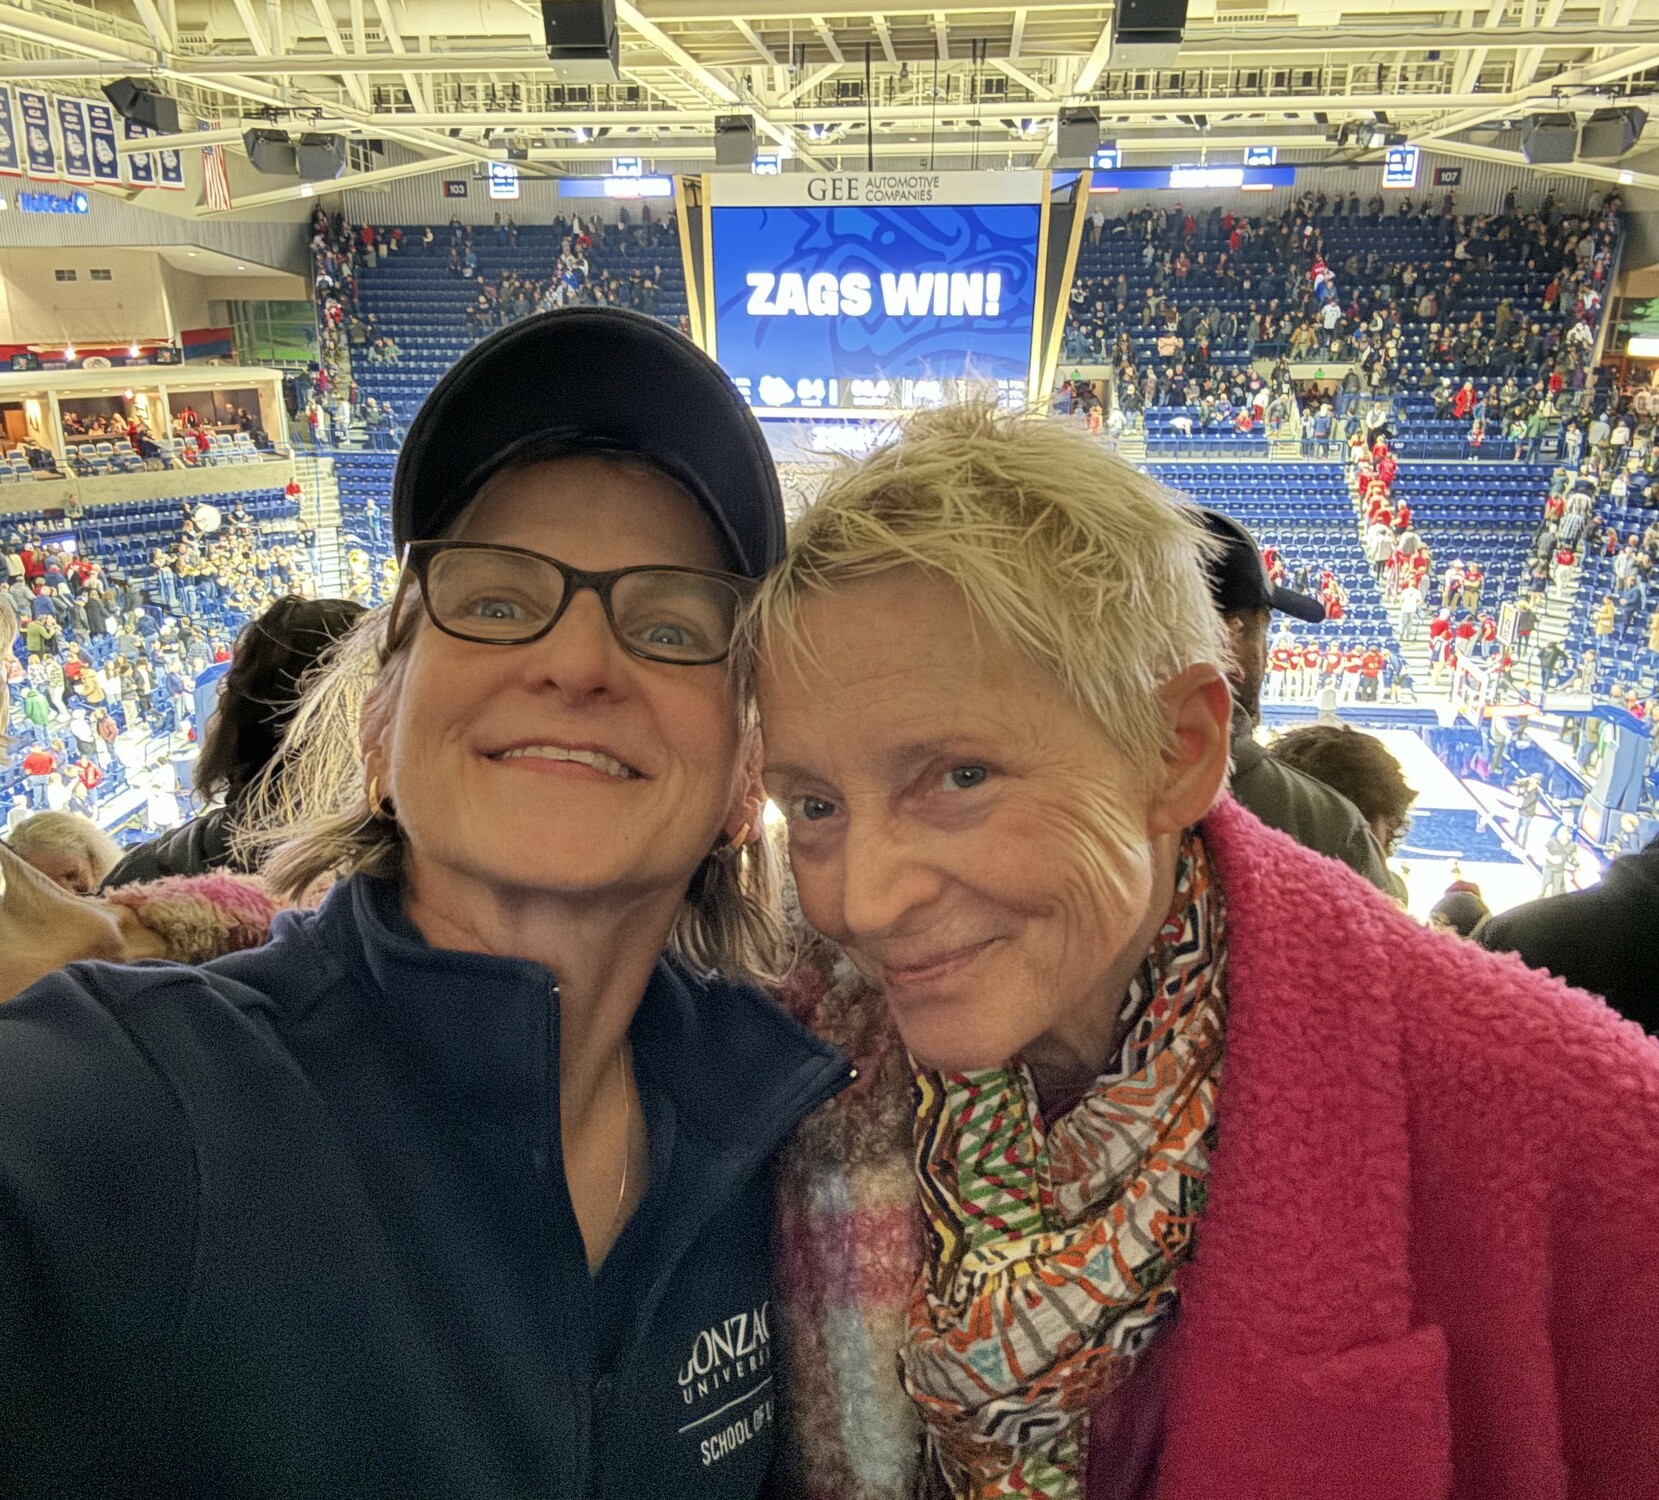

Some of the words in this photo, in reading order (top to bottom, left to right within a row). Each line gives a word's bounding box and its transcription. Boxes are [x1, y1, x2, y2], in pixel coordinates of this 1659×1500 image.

[865, 176, 940, 189] AUTOMOTIVE
[1441, 172, 1458, 182] 107
[449, 184, 465, 194] 103
[807, 178, 859, 201] GEE
[865, 189, 933, 202] COMPANIES
[746, 272, 872, 316] ZAGS
[880, 272, 1001, 316] WIN!
[700, 1418, 754, 1466] SCHOOL
